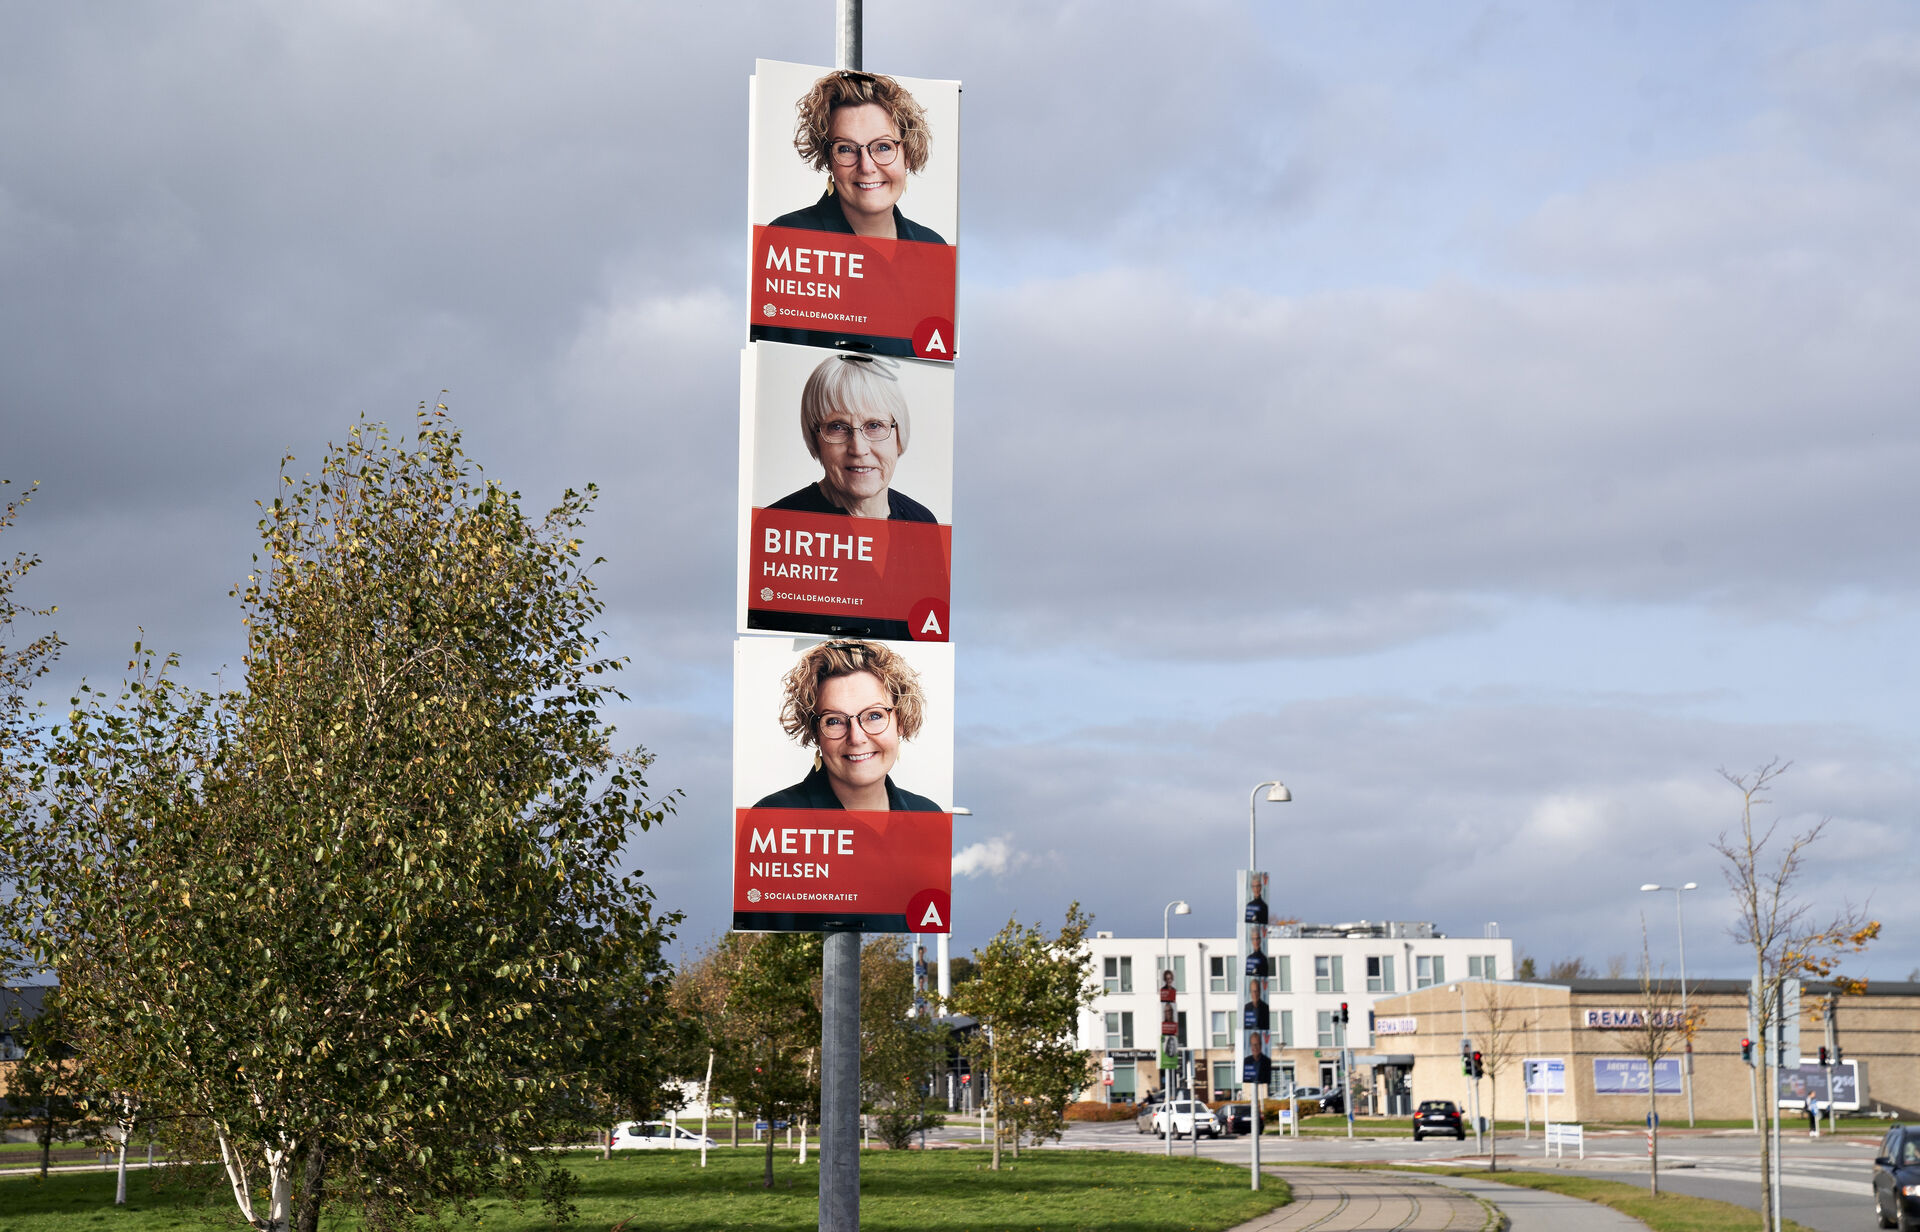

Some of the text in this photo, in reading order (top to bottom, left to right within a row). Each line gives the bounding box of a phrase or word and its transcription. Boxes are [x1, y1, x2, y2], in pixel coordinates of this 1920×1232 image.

[765, 245, 865, 279] METTE
[765, 277, 841, 300] NIELSEN
[779, 308, 868, 323] SOCIALDEMOKRATIET
[925, 328, 947, 353] A
[764, 527, 873, 562] BIRTHE
[763, 561, 839, 582] HARRITZ
[776, 592, 864, 606] SOCIALDEMOKRATIET
[920, 609, 943, 635] A
[749, 827, 854, 855] METTE
[749, 861, 829, 879] NIELSEN
[764, 892, 858, 901] SOCIALDEMOKRATIET
[920, 901, 943, 926] A
[1588, 1011, 1641, 1025] REMA
[1619, 1072, 1651, 1089] 7-2
